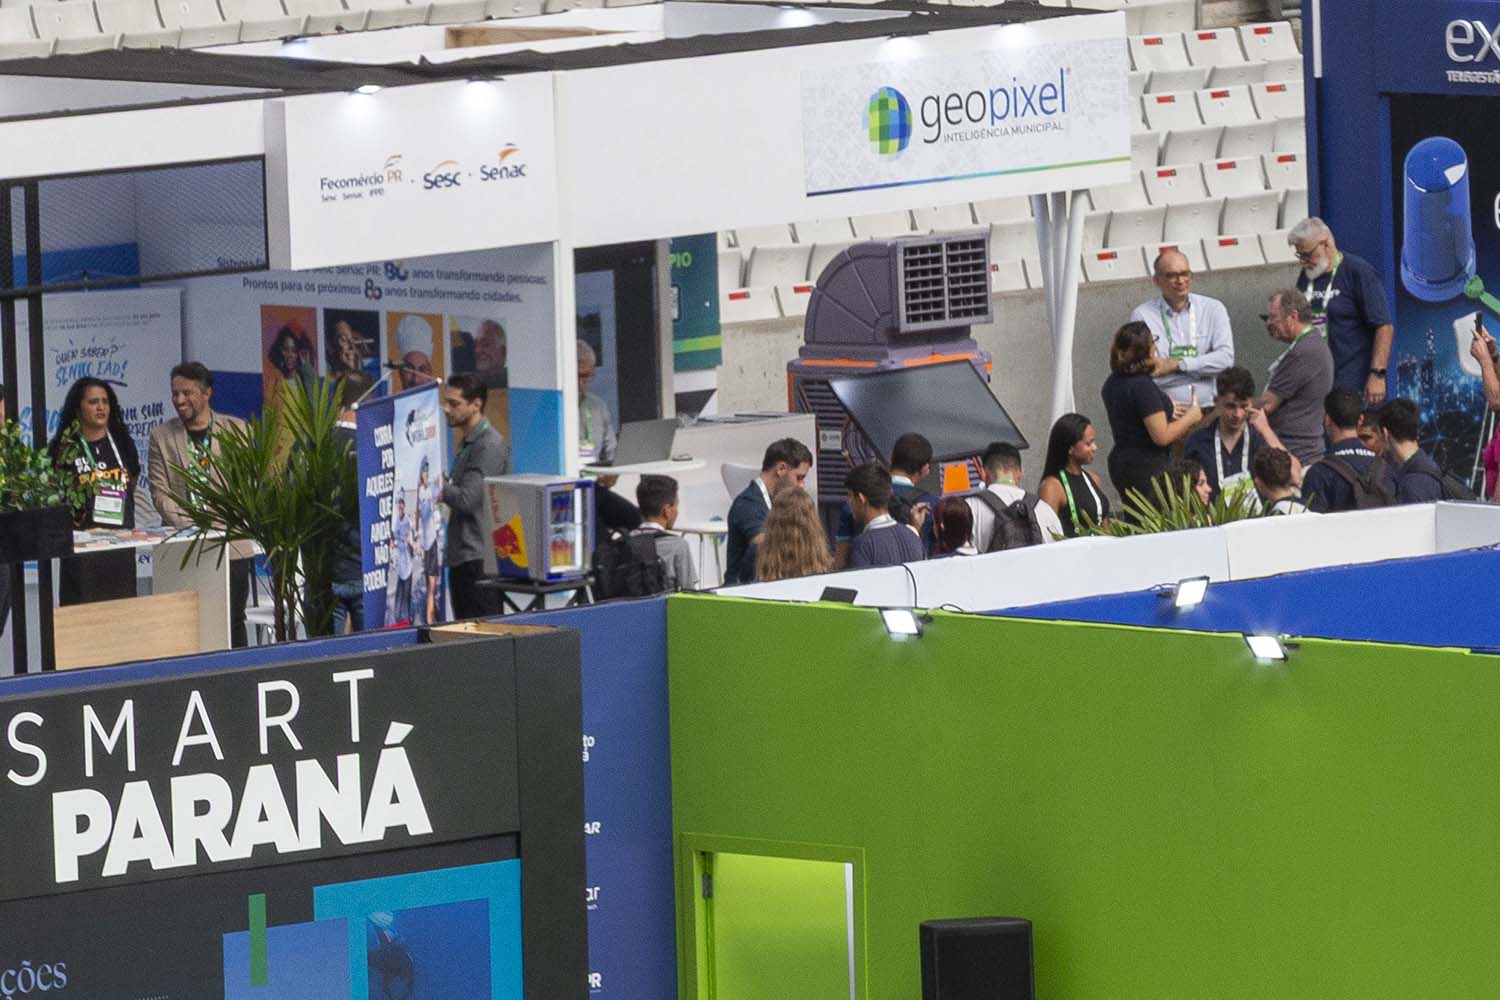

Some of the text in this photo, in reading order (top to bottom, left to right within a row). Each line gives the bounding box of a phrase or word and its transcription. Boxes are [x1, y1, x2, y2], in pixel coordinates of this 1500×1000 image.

[921, 68, 1066, 144] geopixel
[1011, 122, 1064, 137] MUNICIPAL
[423, 171, 461, 190] Sesc
[480, 163, 527, 181] Senac
[320, 173, 384, 190] Fecomércio
[243, 277, 278, 289] Prontos
[281, 281, 302, 293] para
[304, 284, 316, 292] os
[317, 281, 361, 295] próximos
[7, 668, 375, 786] SMART
[52, 721, 433, 883] PARANÁ
